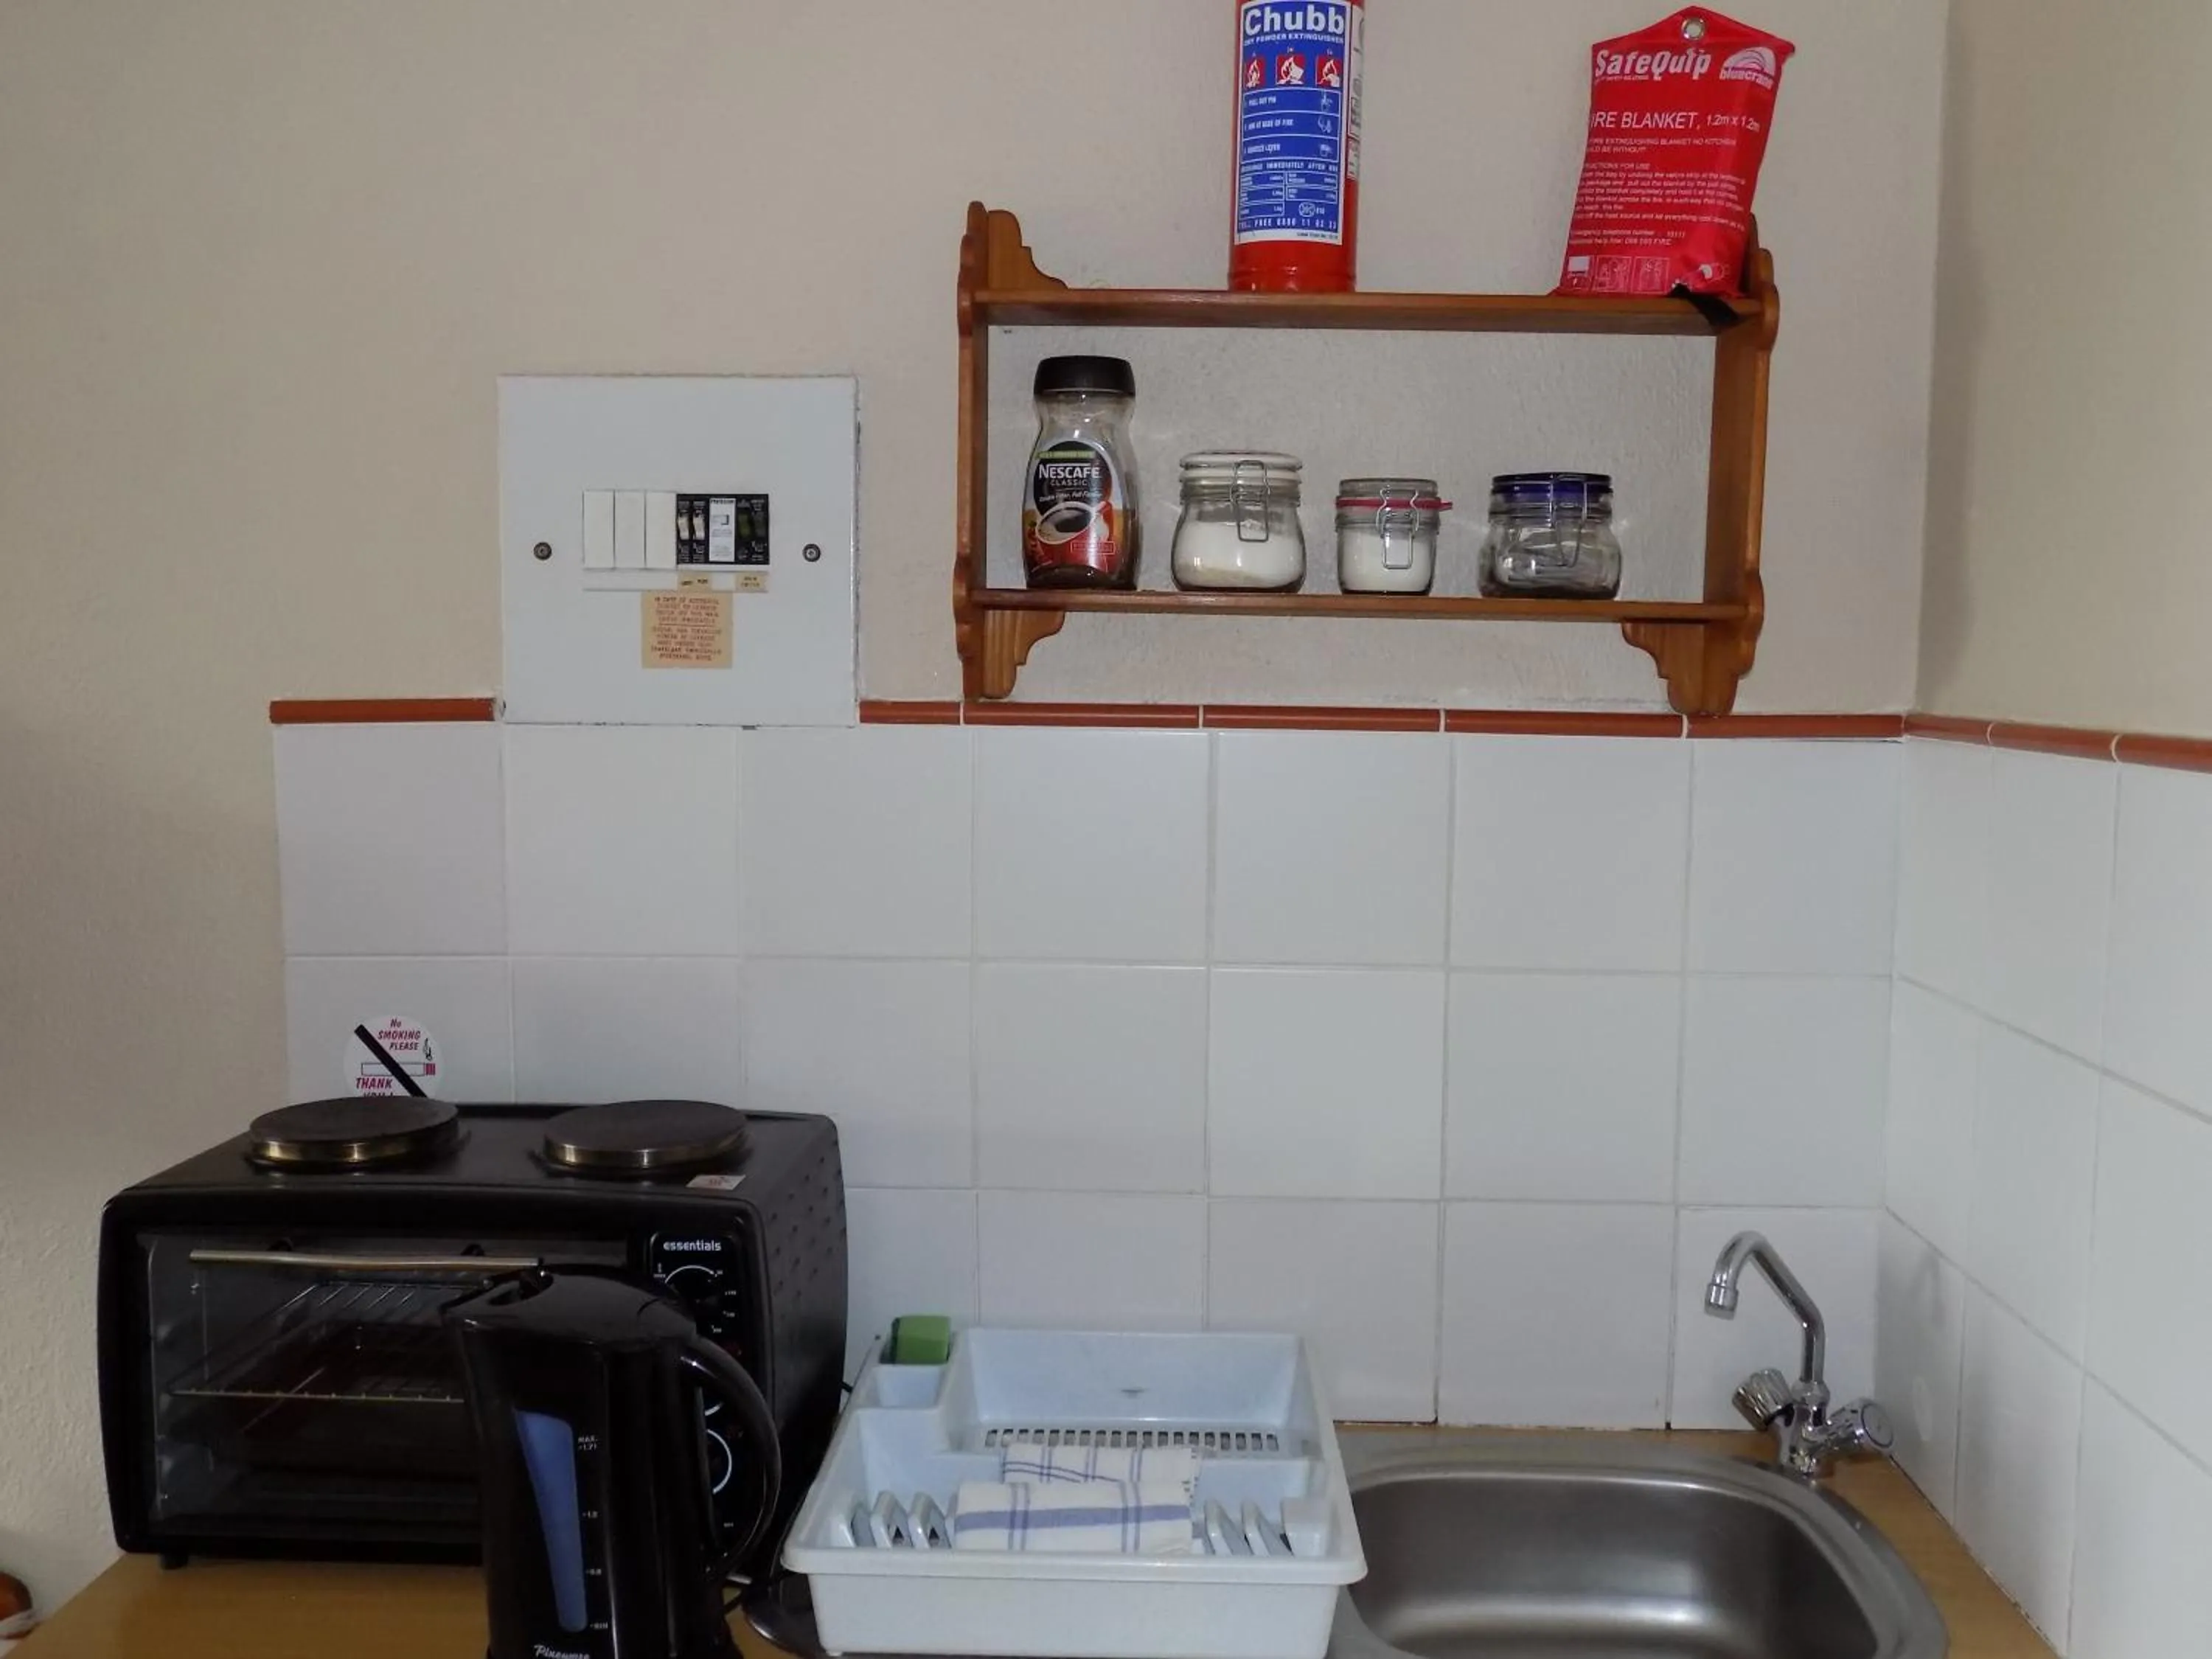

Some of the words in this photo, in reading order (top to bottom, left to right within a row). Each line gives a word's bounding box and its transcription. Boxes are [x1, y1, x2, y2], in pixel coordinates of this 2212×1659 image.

[1245, 4, 1345, 36] Chubb
[1256, 34, 1287, 43] POWDER
[1288, 33, 1343, 44] EXTINGUISHER
[1595, 48, 1711, 81] SafeQuip
[1621, 111, 1700, 131] BLANKET,
[1266, 161, 1304, 170] IMMEDIATELY
[1308, 162, 1326, 170] AFTER
[391, 1019, 402, 1028] No
[378, 1031, 421, 1040] SMOKING
[389, 1042, 420, 1051] PLEASE
[356, 1078, 393, 1089] THANK
[663, 1239, 722, 1251] essentials
